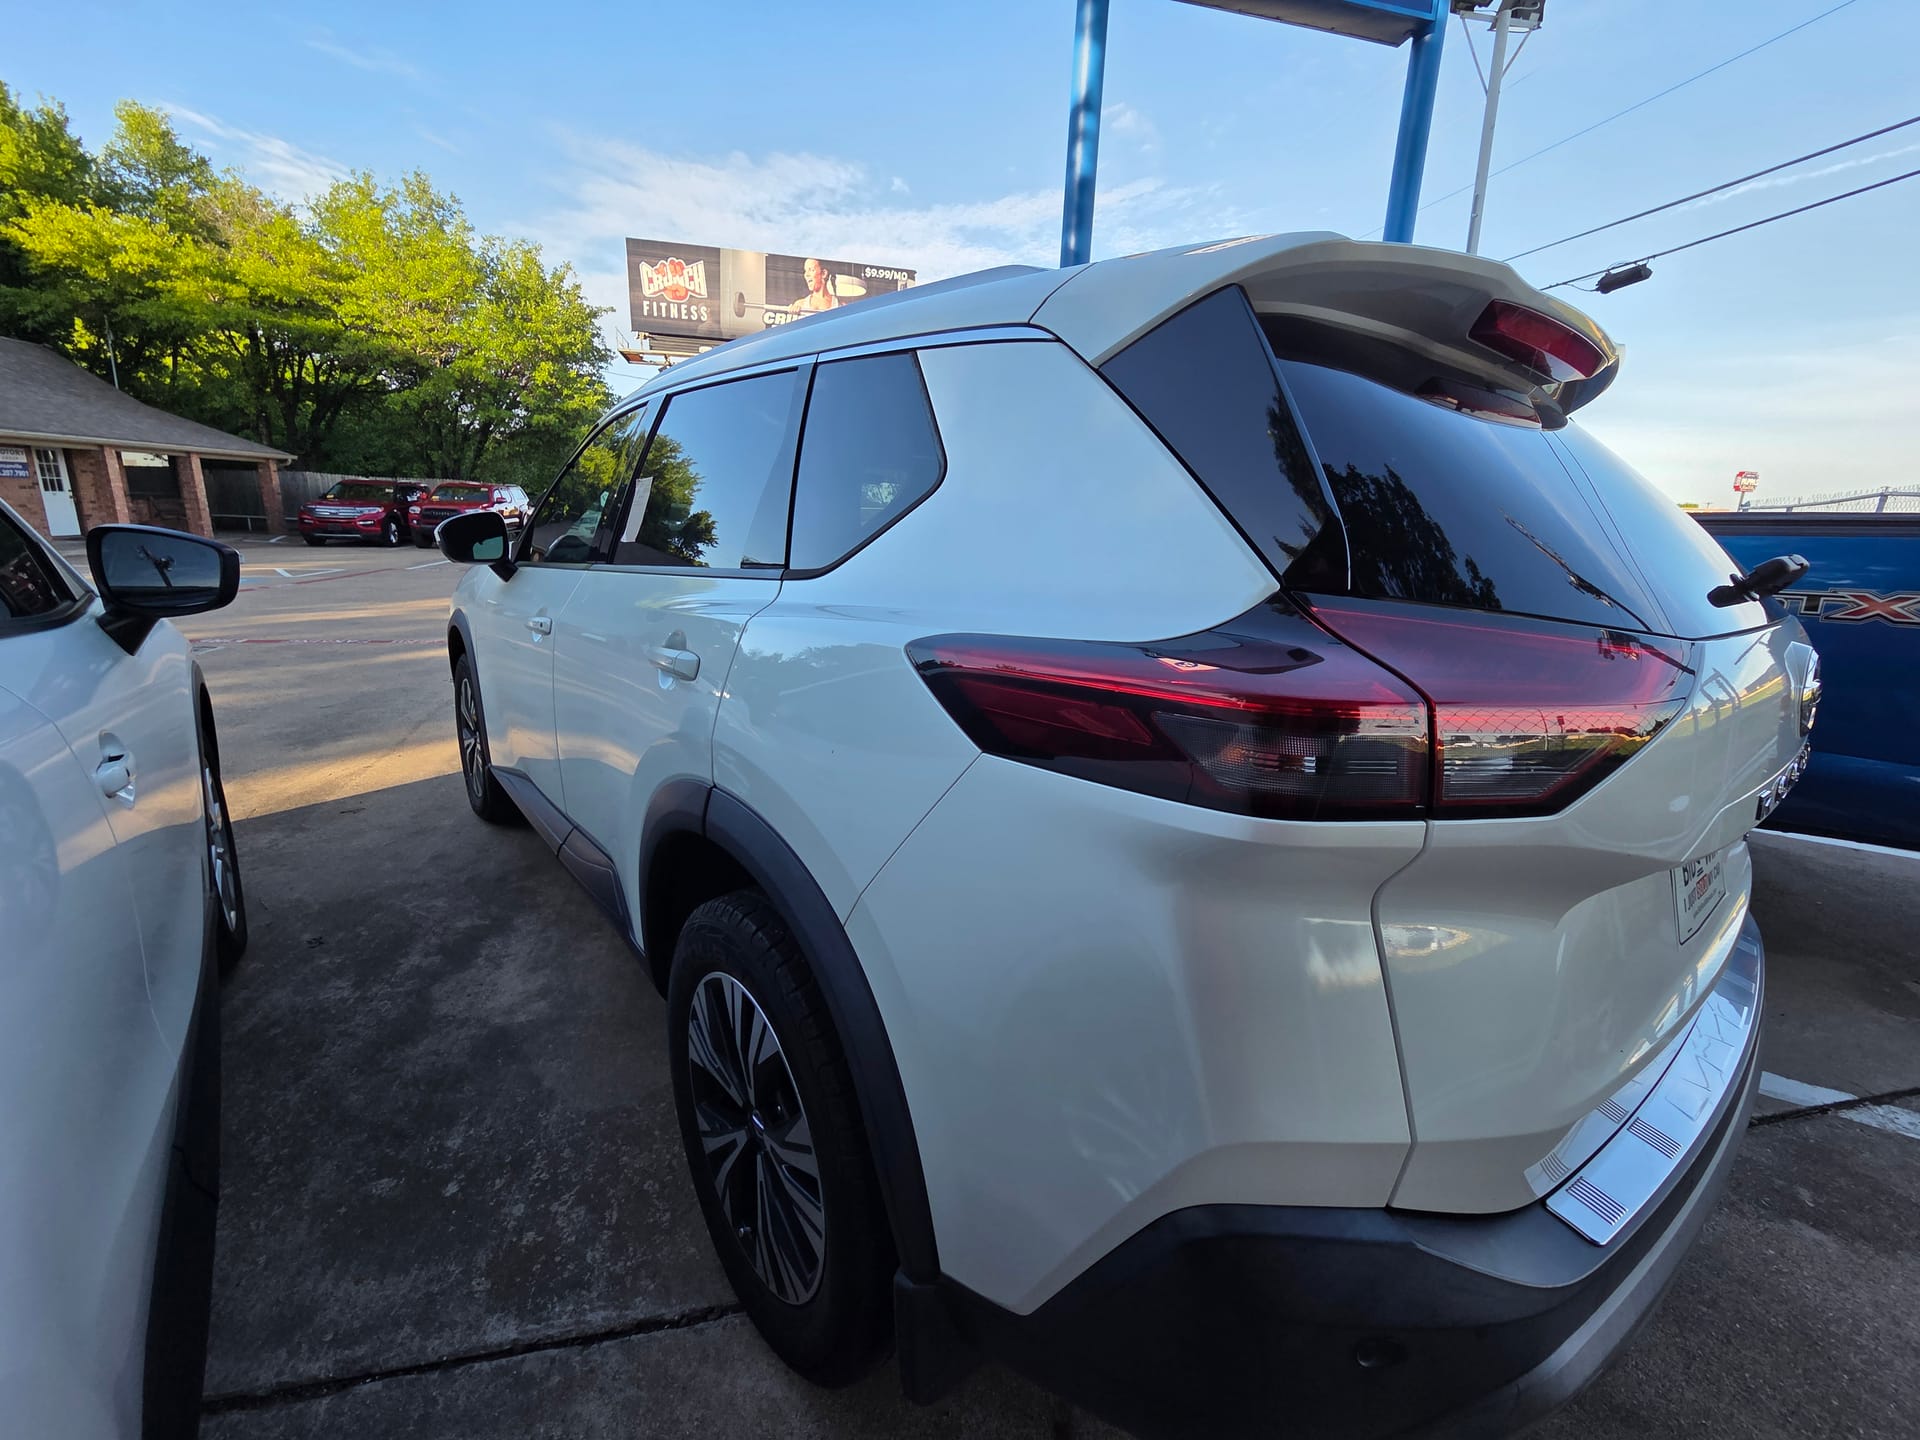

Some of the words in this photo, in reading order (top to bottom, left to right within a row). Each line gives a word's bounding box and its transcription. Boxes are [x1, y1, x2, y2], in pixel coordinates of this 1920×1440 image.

[640, 260, 707, 296] CRUNCH
[865, 266, 908, 281] $9.99/MO
[643, 300, 707, 321] FITNESS
